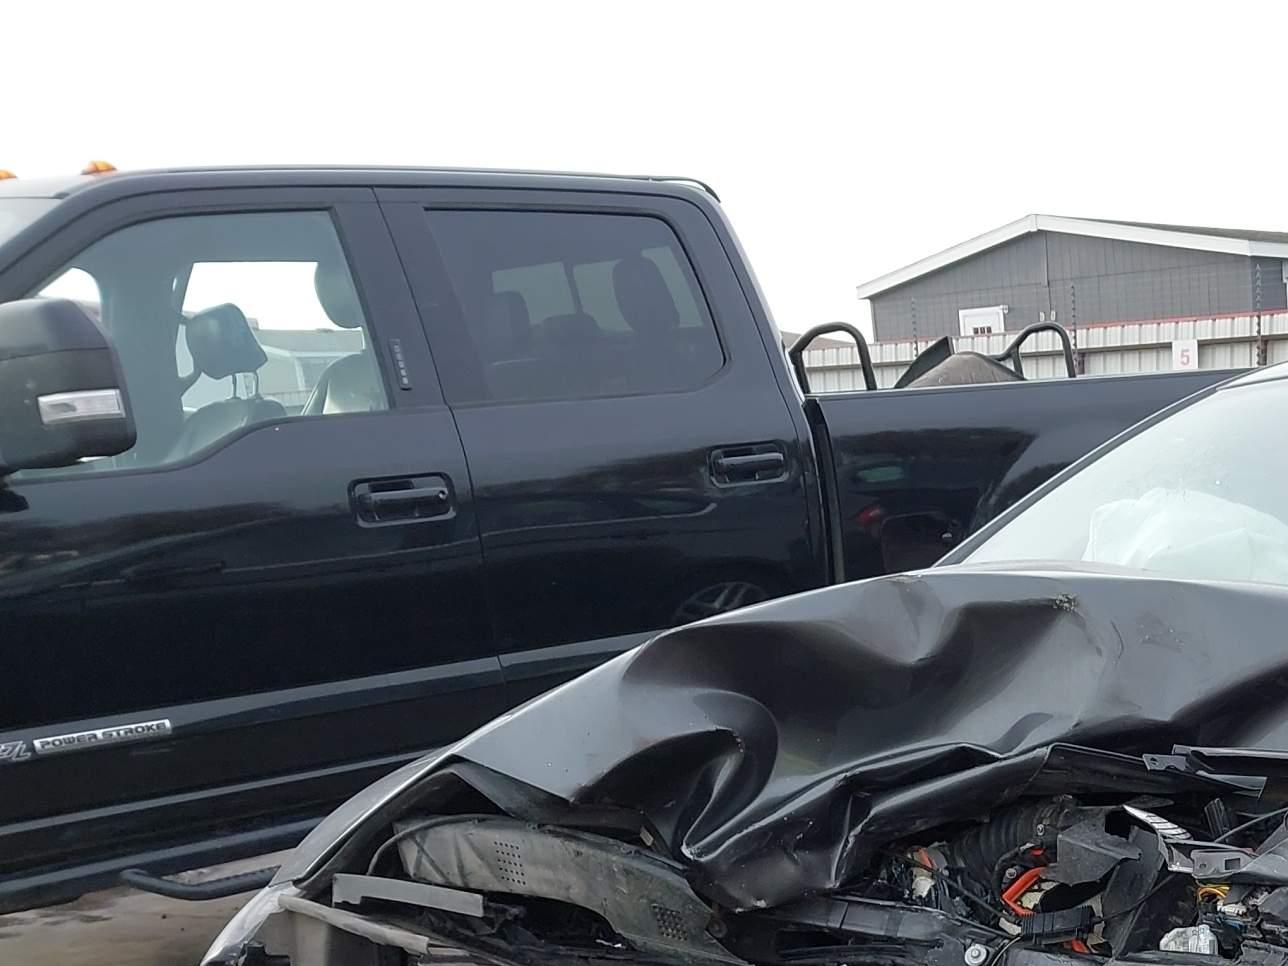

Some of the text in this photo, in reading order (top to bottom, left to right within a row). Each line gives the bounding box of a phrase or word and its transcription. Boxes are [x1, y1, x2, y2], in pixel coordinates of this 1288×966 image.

[1180, 348, 1191, 366] 5
[40, 733, 97, 750] POWER
[101, 722, 167, 739] STROKE
